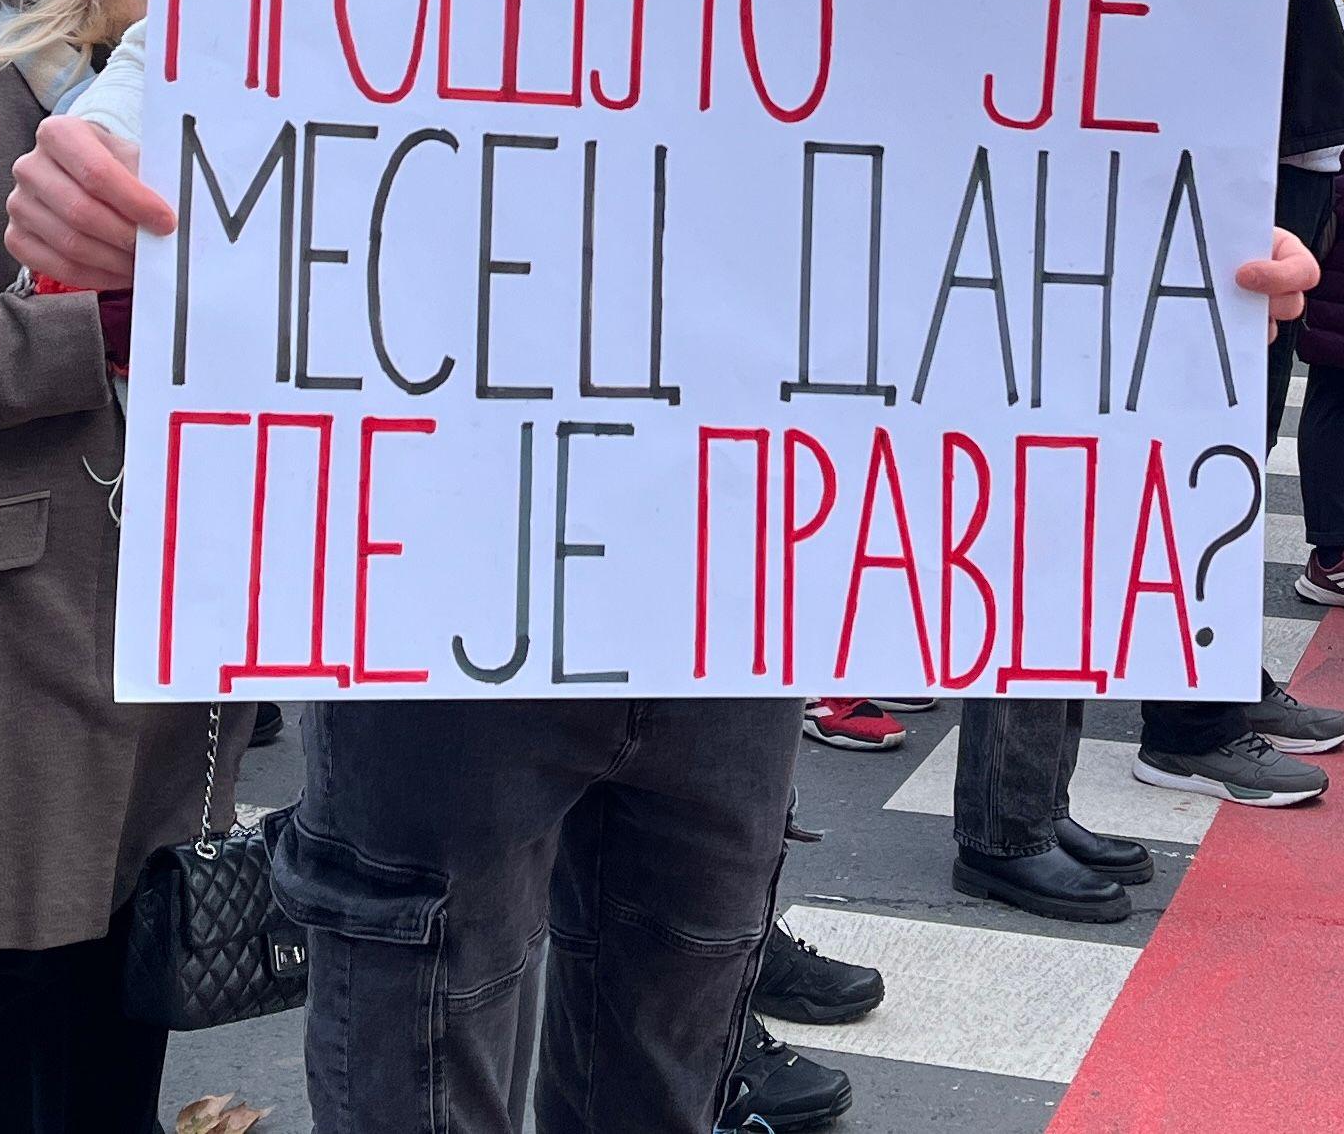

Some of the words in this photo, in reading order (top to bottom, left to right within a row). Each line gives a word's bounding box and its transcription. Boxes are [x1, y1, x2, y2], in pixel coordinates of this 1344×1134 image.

[172, 113, 681, 406] МЕСЕЦ
[780, 141, 1238, 414] ДАНА
[159, 410, 437, 694] ГДЕ
[453, 420, 635, 684] ЈЕ
[694, 427, 1262, 694] ПРАВДА?
